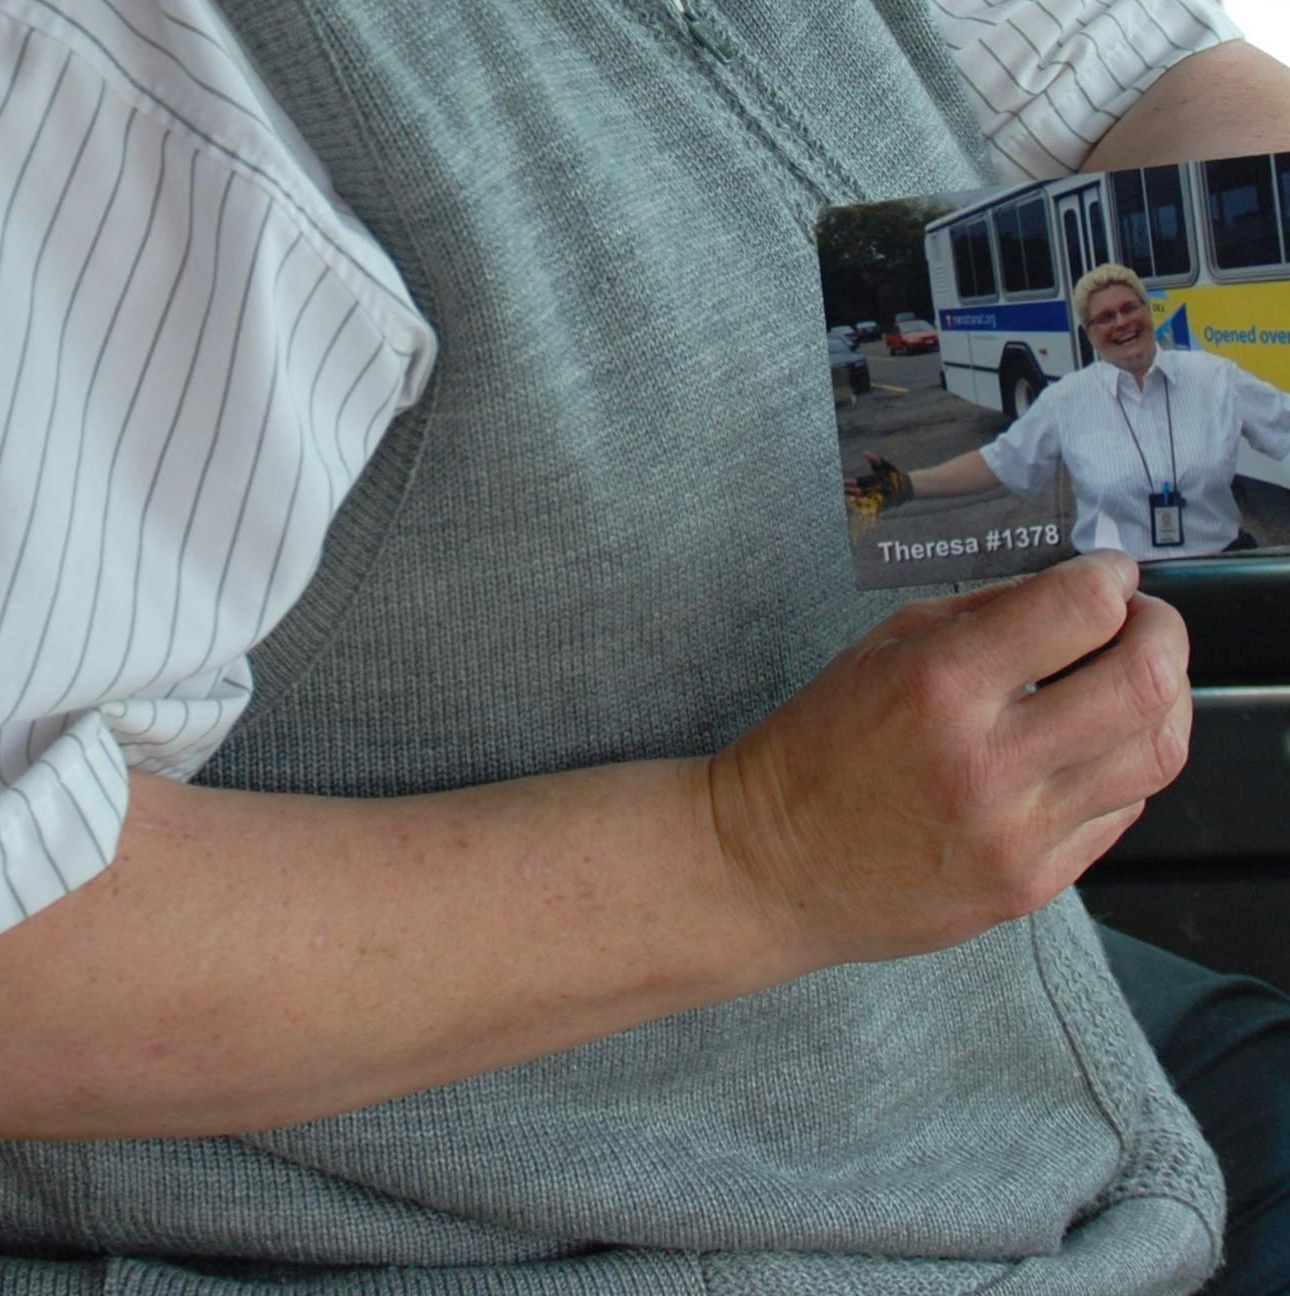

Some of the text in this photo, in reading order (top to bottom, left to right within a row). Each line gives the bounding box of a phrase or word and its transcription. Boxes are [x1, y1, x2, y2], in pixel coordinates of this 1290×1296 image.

[1204, 325, 1257, 347] Opened
[877, 524, 1060, 563] Theresa #1378
